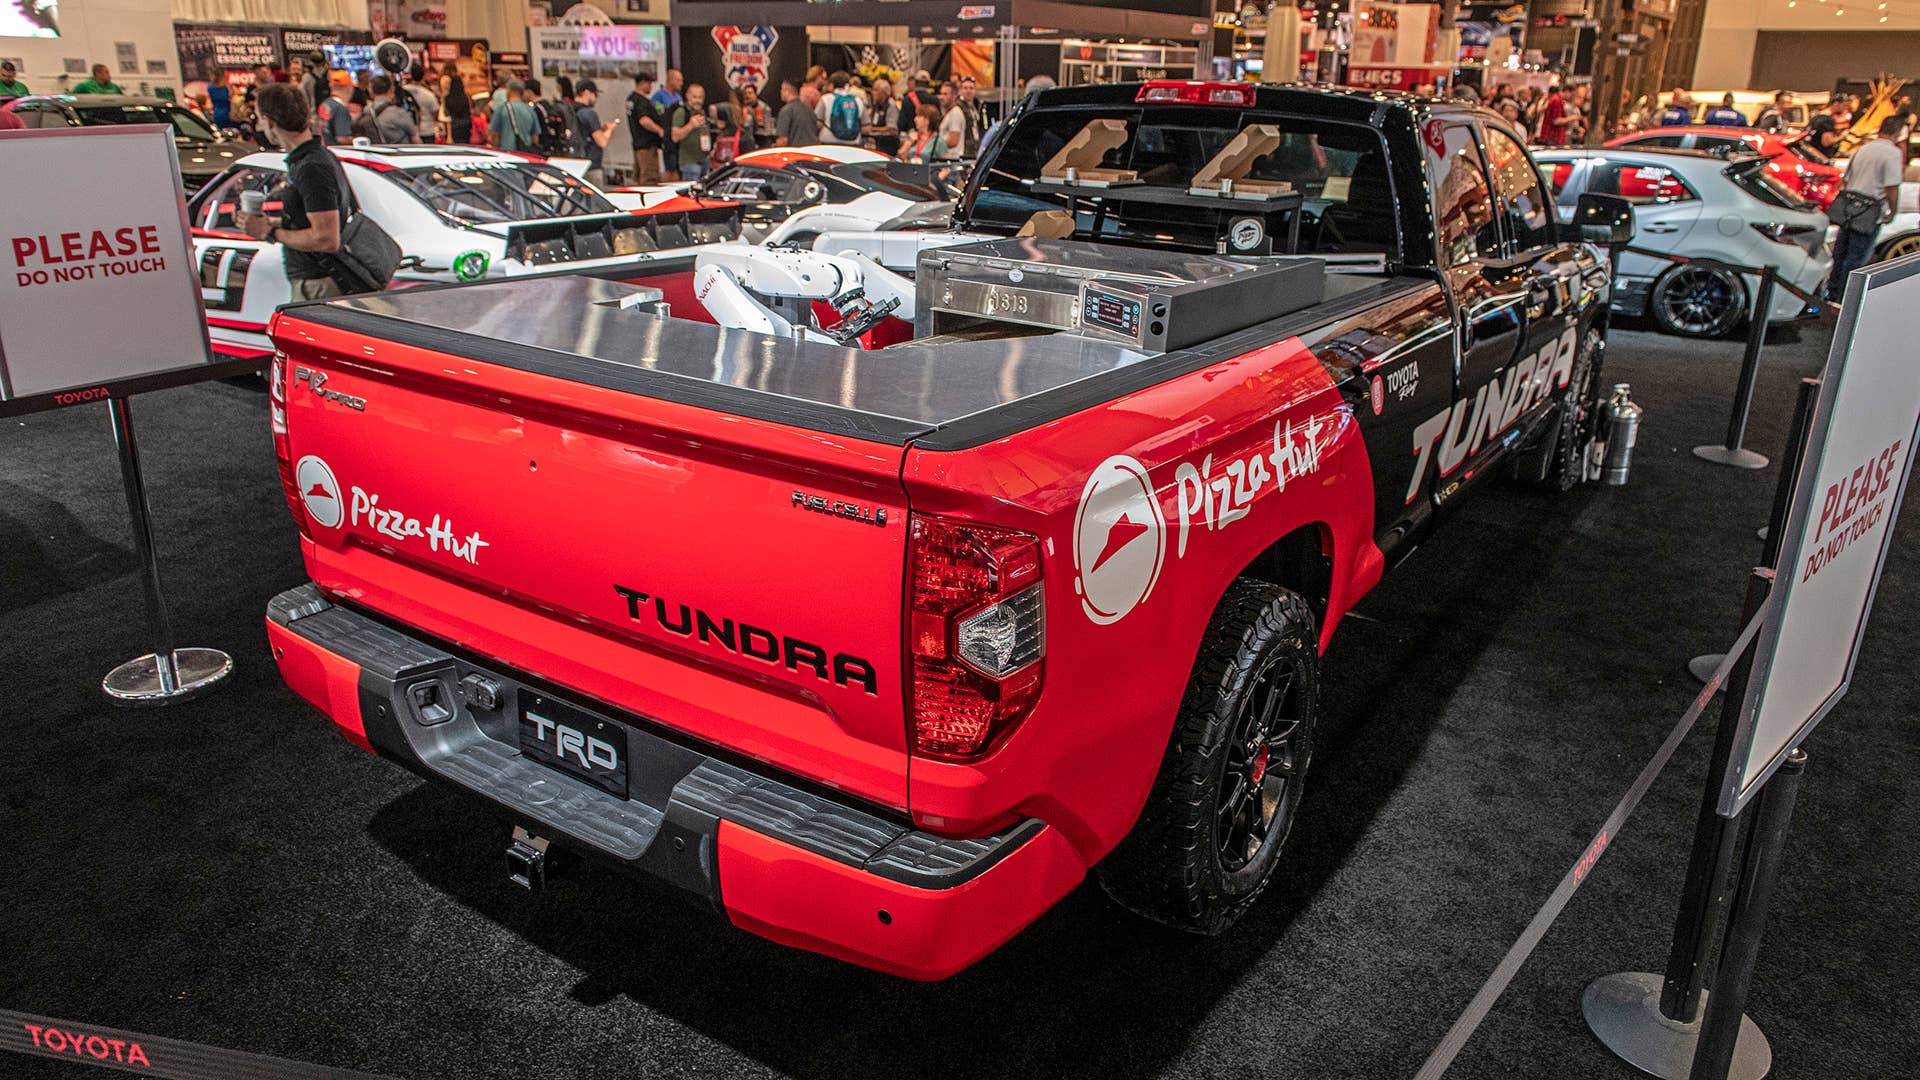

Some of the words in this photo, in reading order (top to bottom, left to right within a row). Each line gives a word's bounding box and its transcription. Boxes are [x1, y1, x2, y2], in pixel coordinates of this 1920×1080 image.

[214, 35, 268, 46] INGENUITY
[216, 45, 228, 55] IS
[229, 45, 247, 56] THE
[248, 46, 272, 56] VERY
[285, 31, 312, 41] ESTER
[541, 39, 567, 50] WHAT
[589, 36, 627, 56] YOU
[217, 54, 260, 65] ESSENCE
[261, 54, 275, 65] OF
[12, 225, 161, 268] PLEASE
[16, 270, 49, 288] DO
[54, 265, 95, 283] NOT
[99, 256, 166, 278] TOUCH
[54, 386, 111, 405] TOYOTA
[1387, 360, 1420, 393] TOYOTA
[1405, 325, 1577, 505] TUNDRA
[1174, 453, 1270, 559] Pizza
[1269, 415, 1324, 493] Hut
[1814, 439, 1902, 544] PLEASE
[351, 486, 425, 541] Pizza
[425, 513, 490, 565] Hut
[1802, 547, 1825, 583] DO
[1823, 525, 1851, 567] NOT
[1848, 498, 1886, 546] TOUCH
[613, 584, 878, 697] TUNDRA
[526, 711, 618, 770] TRD
[25, 1023, 150, 1067] TOYOTA
